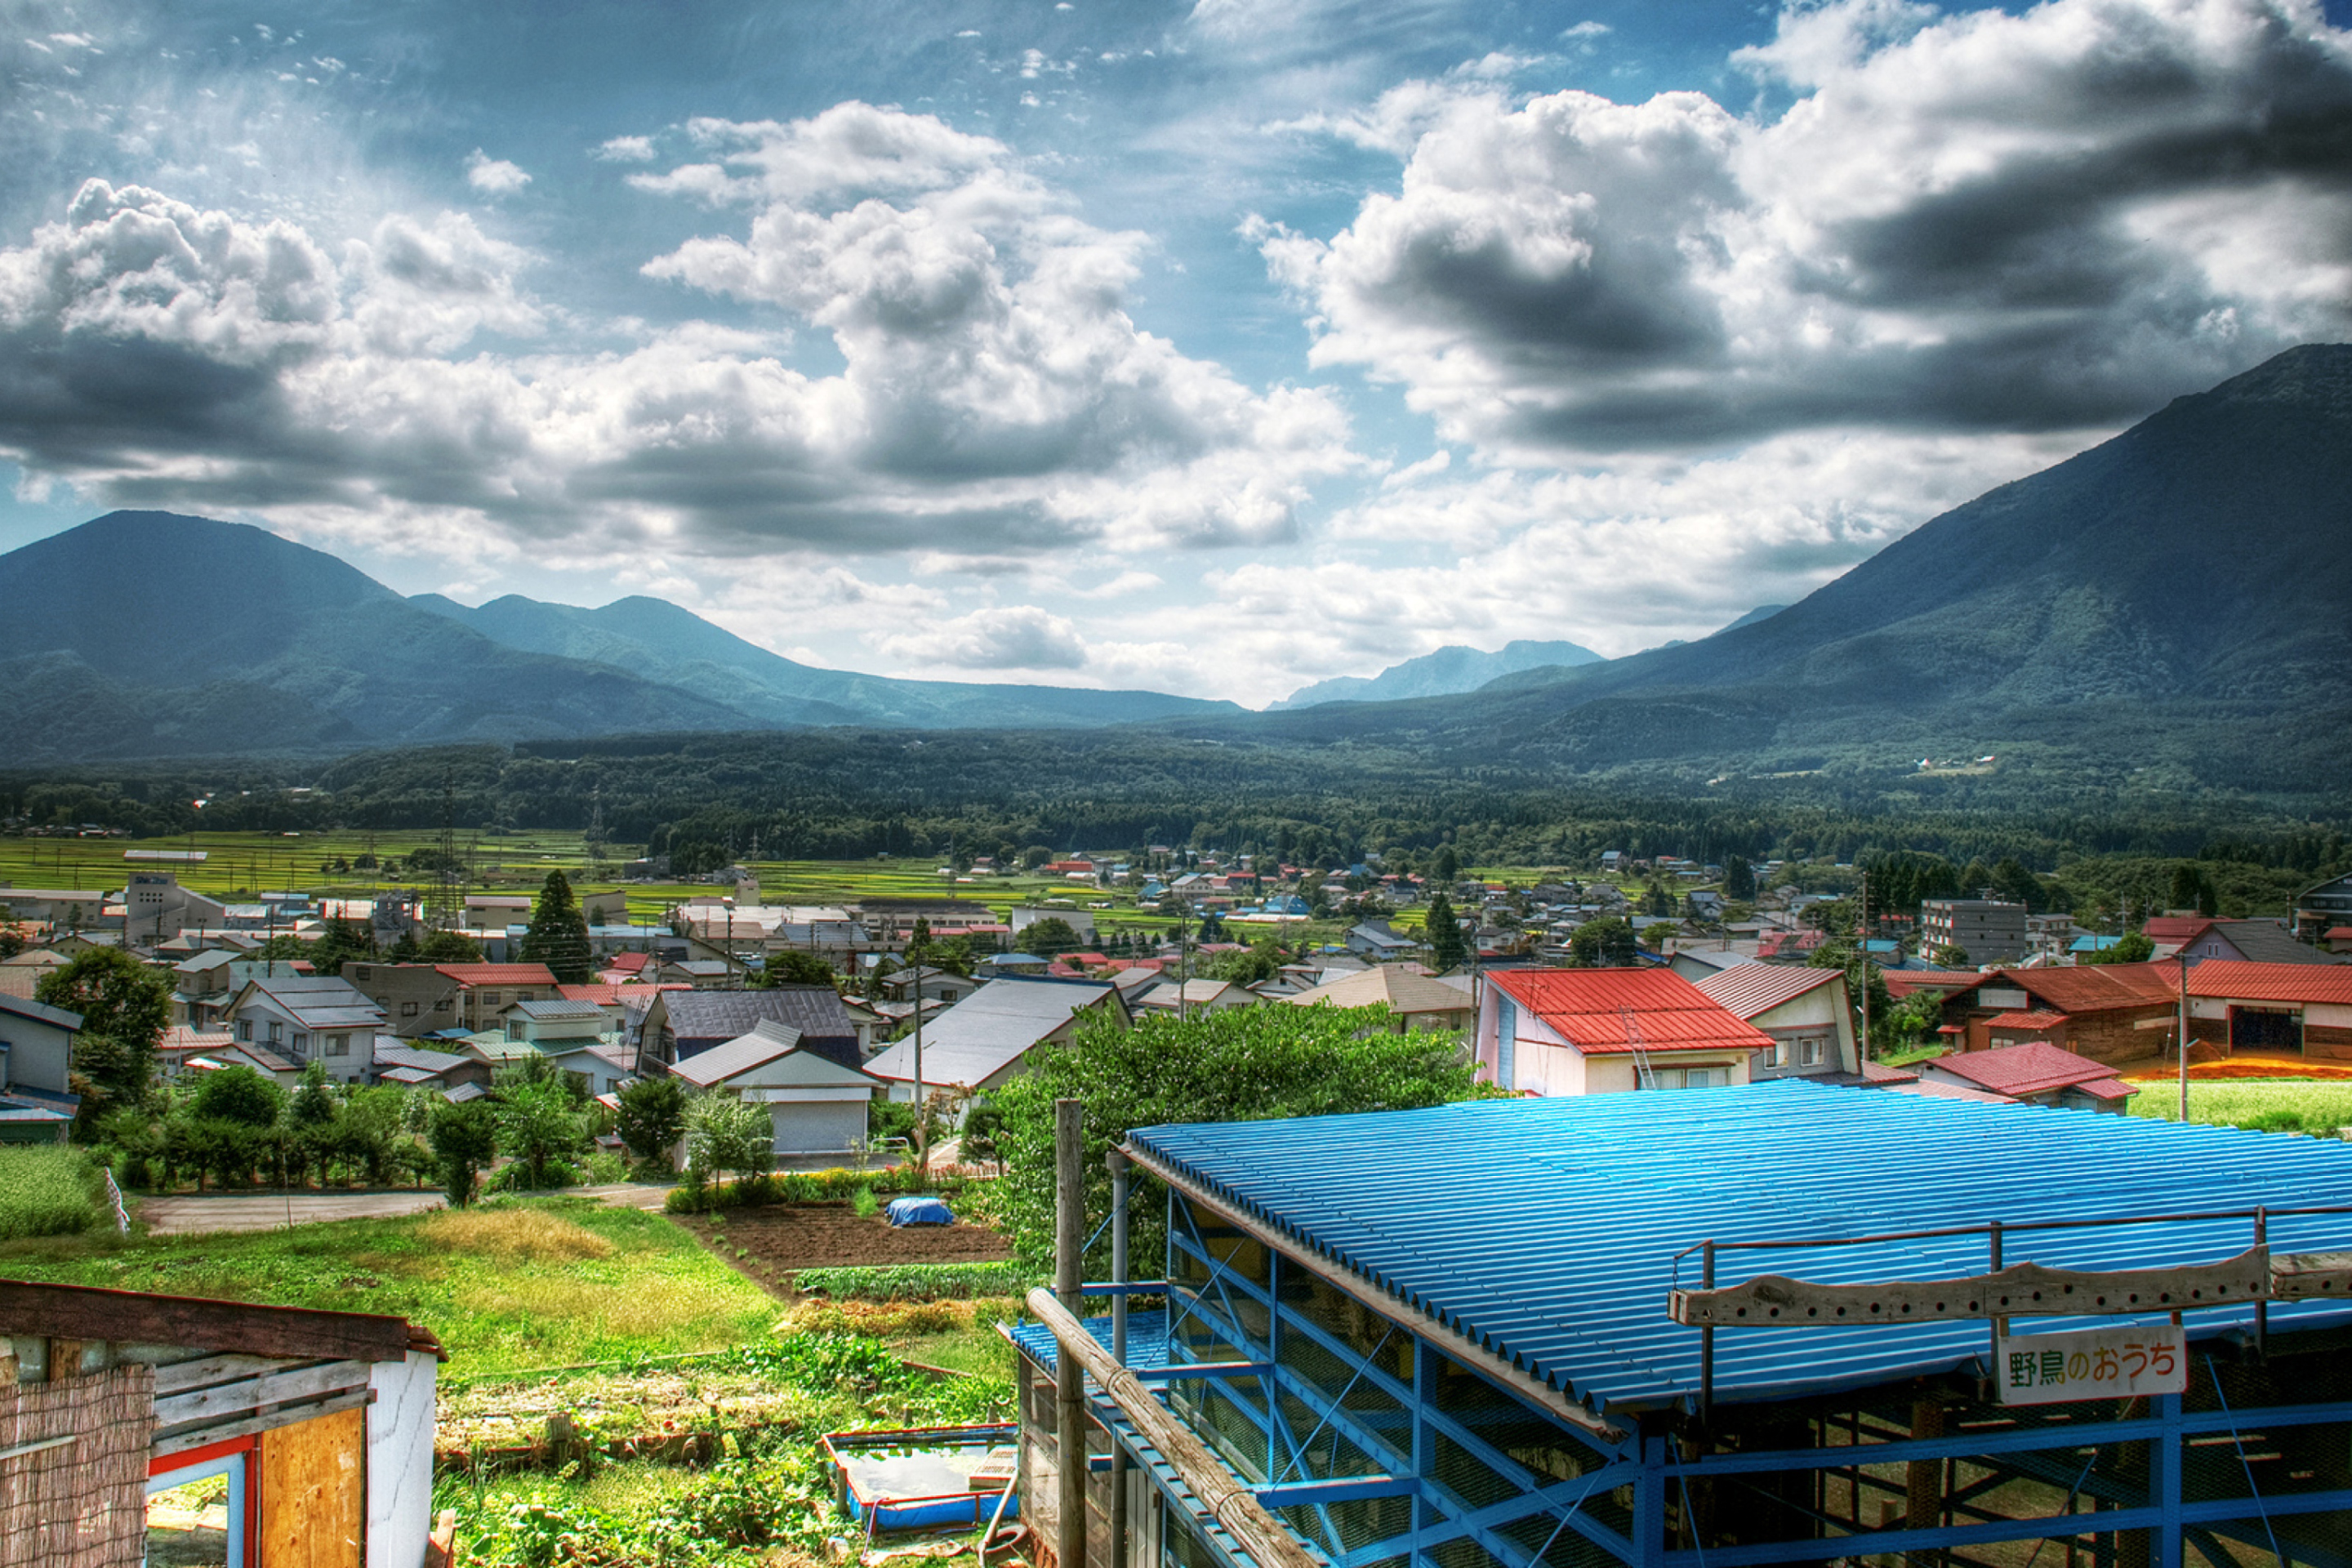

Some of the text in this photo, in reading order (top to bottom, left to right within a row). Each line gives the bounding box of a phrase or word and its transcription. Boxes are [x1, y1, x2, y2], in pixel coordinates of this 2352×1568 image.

[2009, 1342, 2176, 1388] 野鳥のおうち
